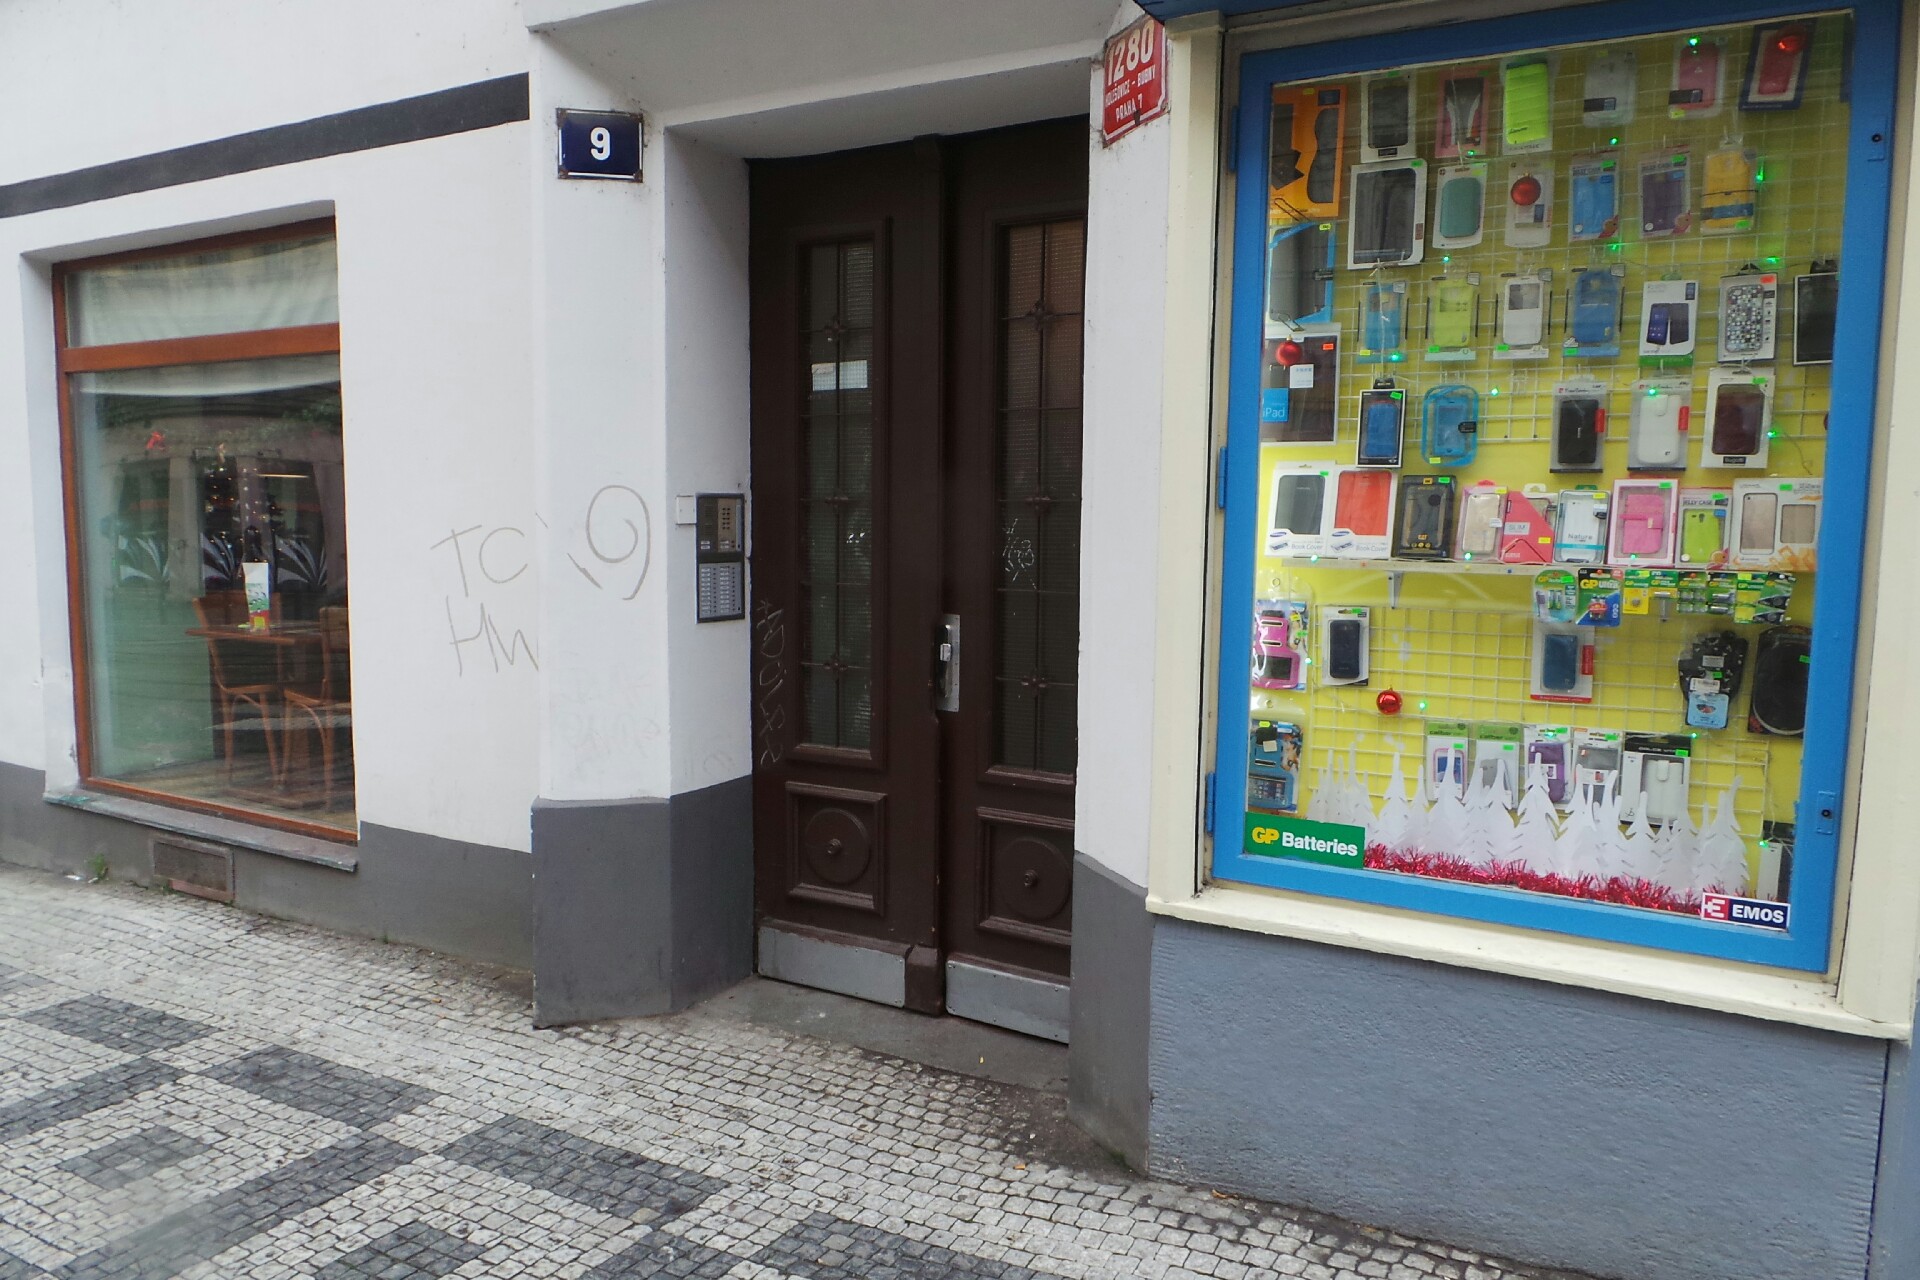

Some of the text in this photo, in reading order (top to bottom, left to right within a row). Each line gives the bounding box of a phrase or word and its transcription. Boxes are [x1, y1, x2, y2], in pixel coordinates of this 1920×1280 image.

[1107, 19, 1155, 86] 1280
[1115, 93, 1143, 123] PRAHA 7
[590, 126, 611, 161] 9
[1580, 579, 1598, 589] GP
[1251, 826, 1359, 857] GP Batteries
[1732, 904, 1784, 923] EMOS
